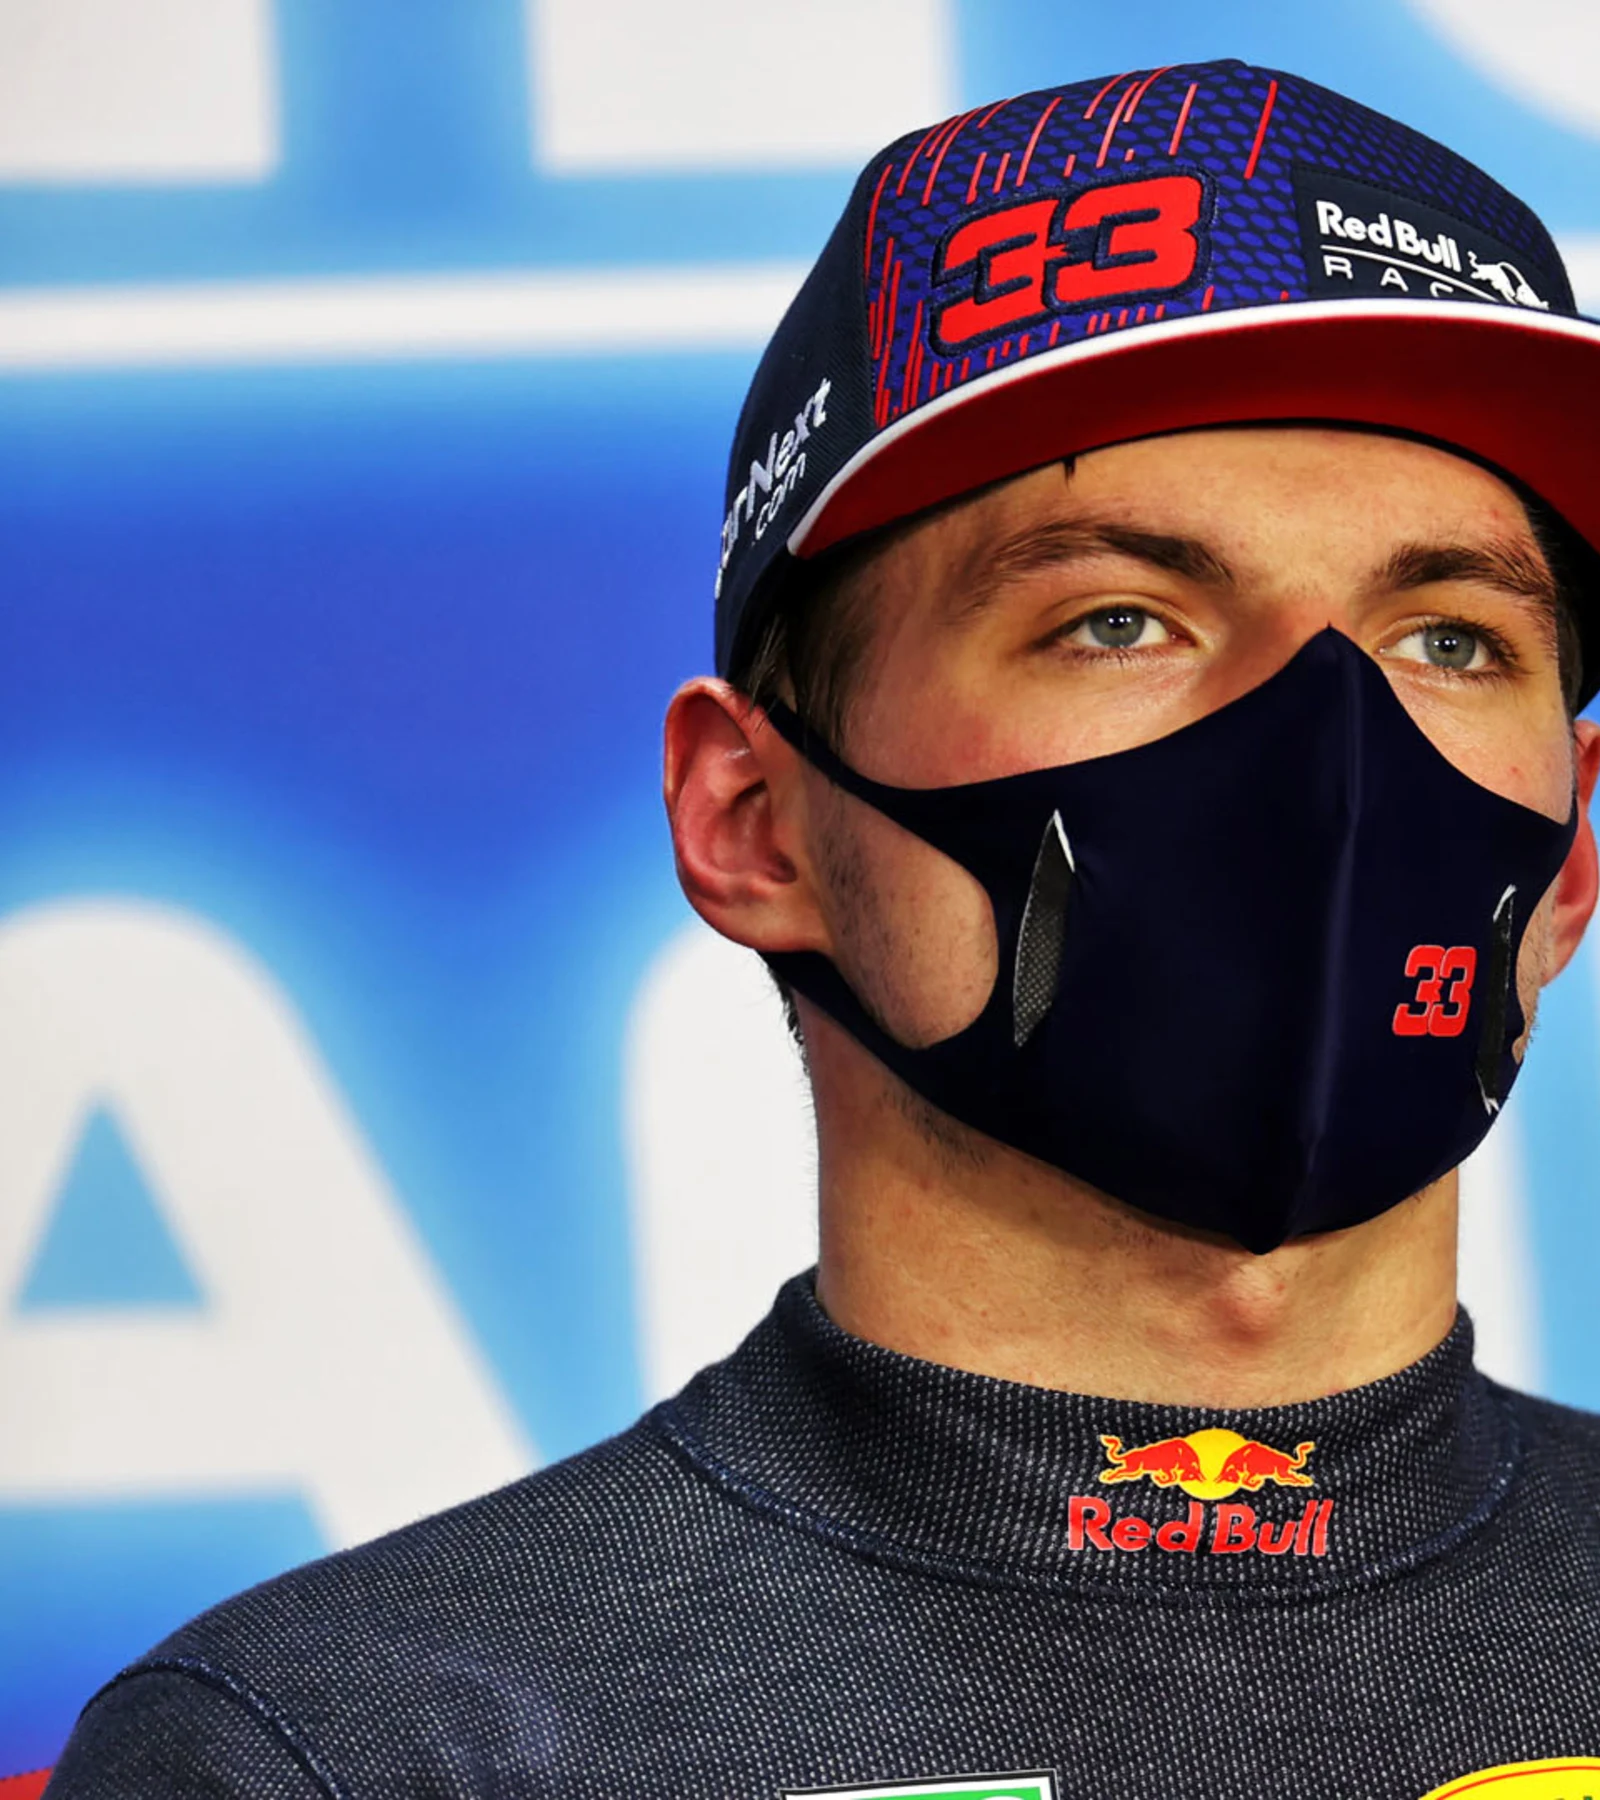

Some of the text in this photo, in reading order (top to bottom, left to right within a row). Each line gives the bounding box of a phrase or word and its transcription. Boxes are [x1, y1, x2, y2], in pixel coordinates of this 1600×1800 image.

[936, 174, 1205, 344] 33
[1315, 200, 1462, 273] Red Bull
[1392, 944, 1478, 1037] 33
[1067, 1495, 1335, 1557] Red Bull
